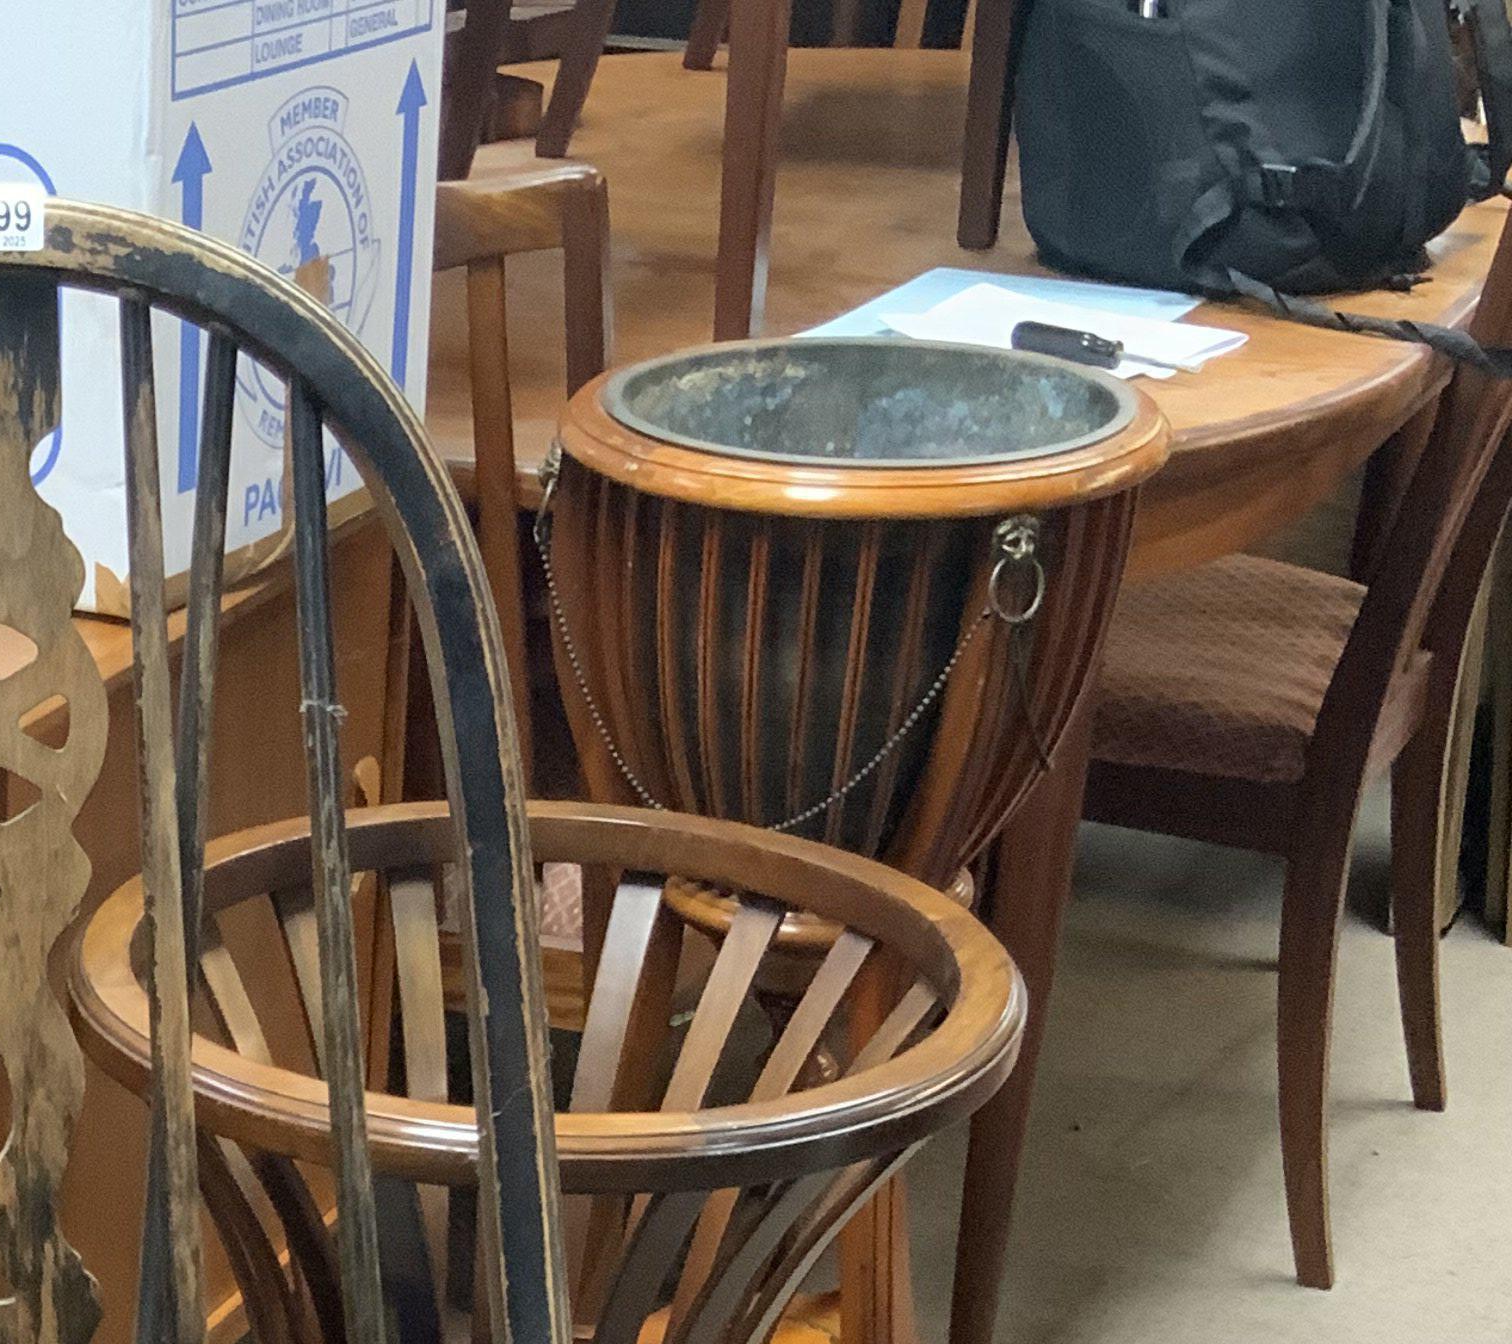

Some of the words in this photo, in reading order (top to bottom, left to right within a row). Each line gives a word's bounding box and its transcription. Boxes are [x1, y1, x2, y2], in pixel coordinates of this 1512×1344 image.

[349, 9, 398, 38] GENERAL
[254, 33, 303, 64] LOUNGE
[279, 97, 340, 137] MEMBER
[242, 176, 276, 254] ITISH
[277, 136, 364, 209] ASSOCIATION
